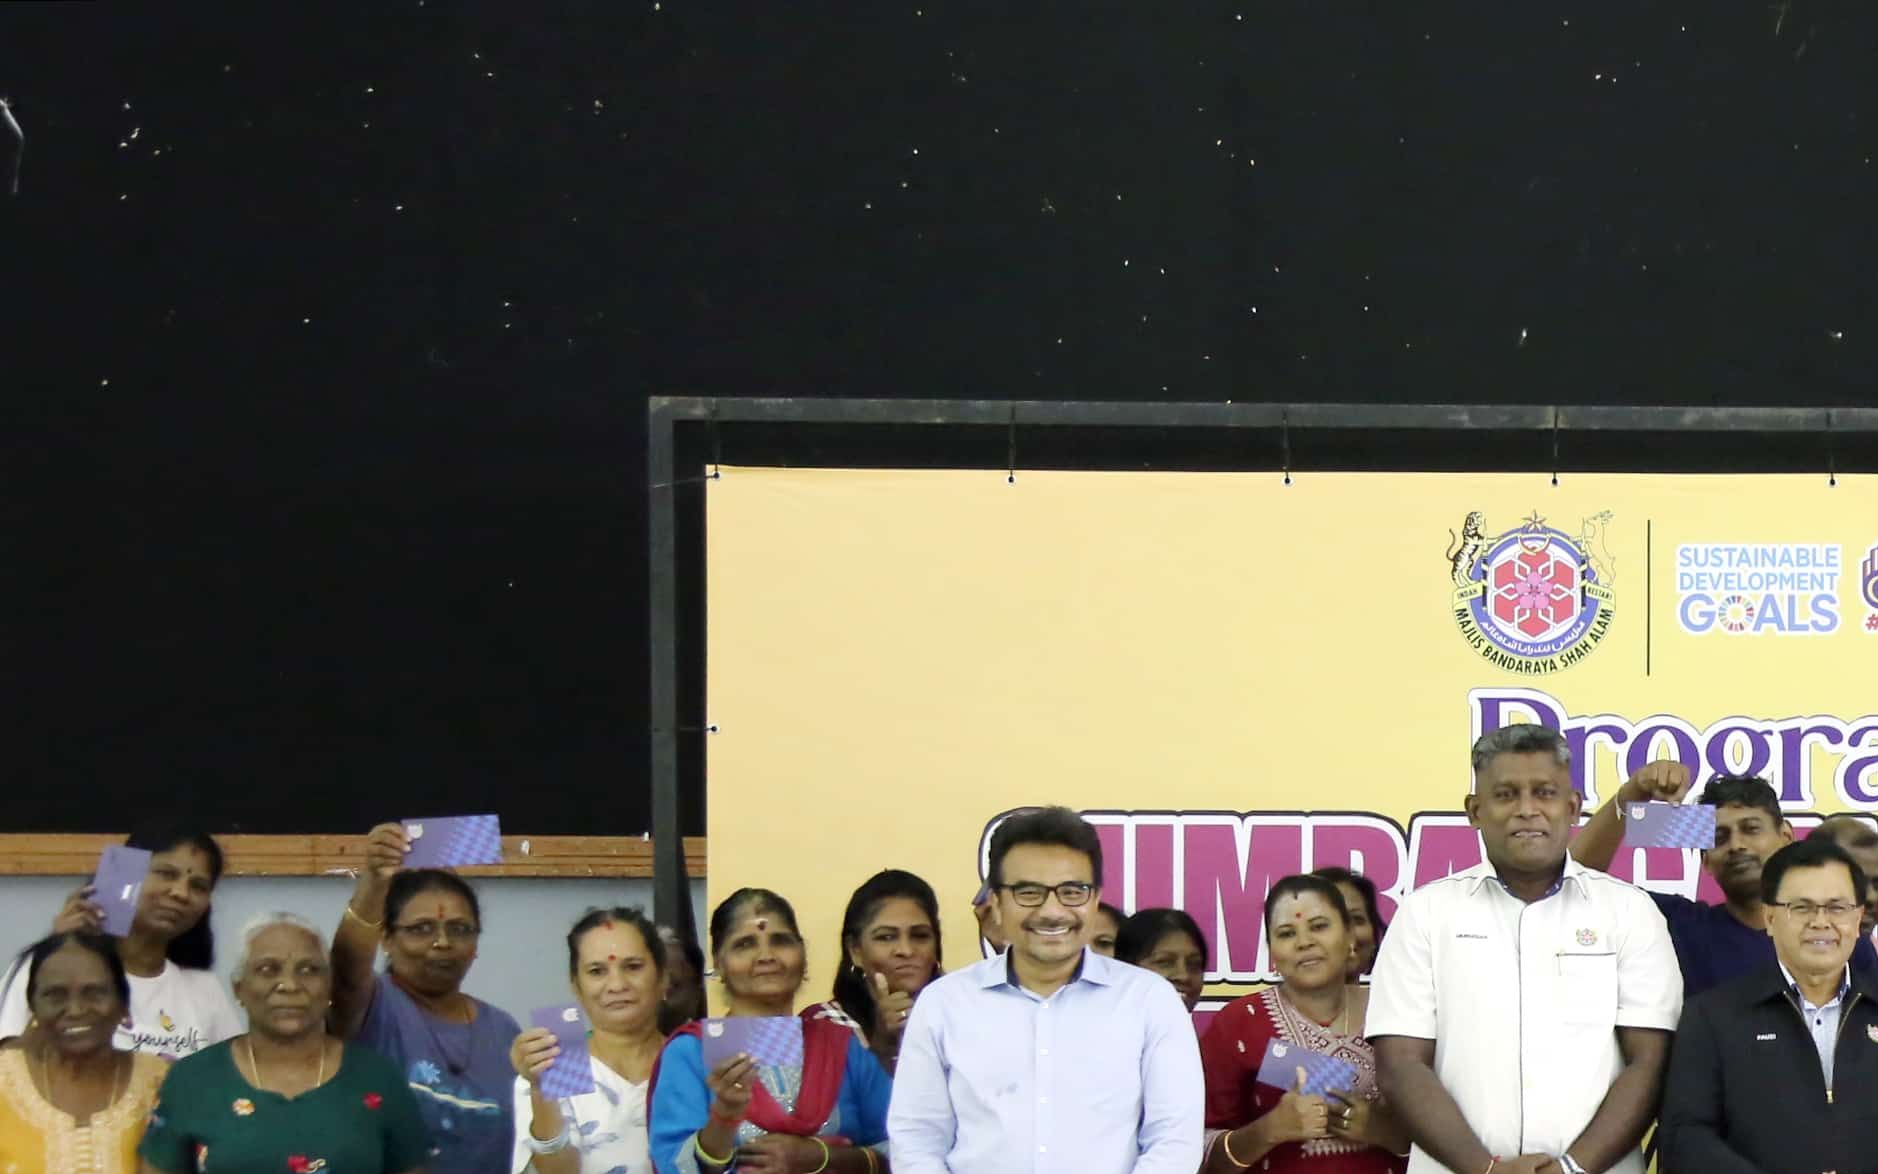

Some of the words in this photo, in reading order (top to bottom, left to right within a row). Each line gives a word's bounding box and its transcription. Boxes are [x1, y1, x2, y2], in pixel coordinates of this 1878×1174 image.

[1679, 547, 1839, 568] SUSTAINABLE
[1679, 572, 1839, 590] DEVELOPMENT
[1680, 593, 1839, 632] GOALS
[1455, 607, 1485, 649] MAJLIS
[1482, 645, 1558, 674] BANDARAYA
[1560, 640, 1592, 667] SHAH
[1594, 608, 1614, 643] ALAM
